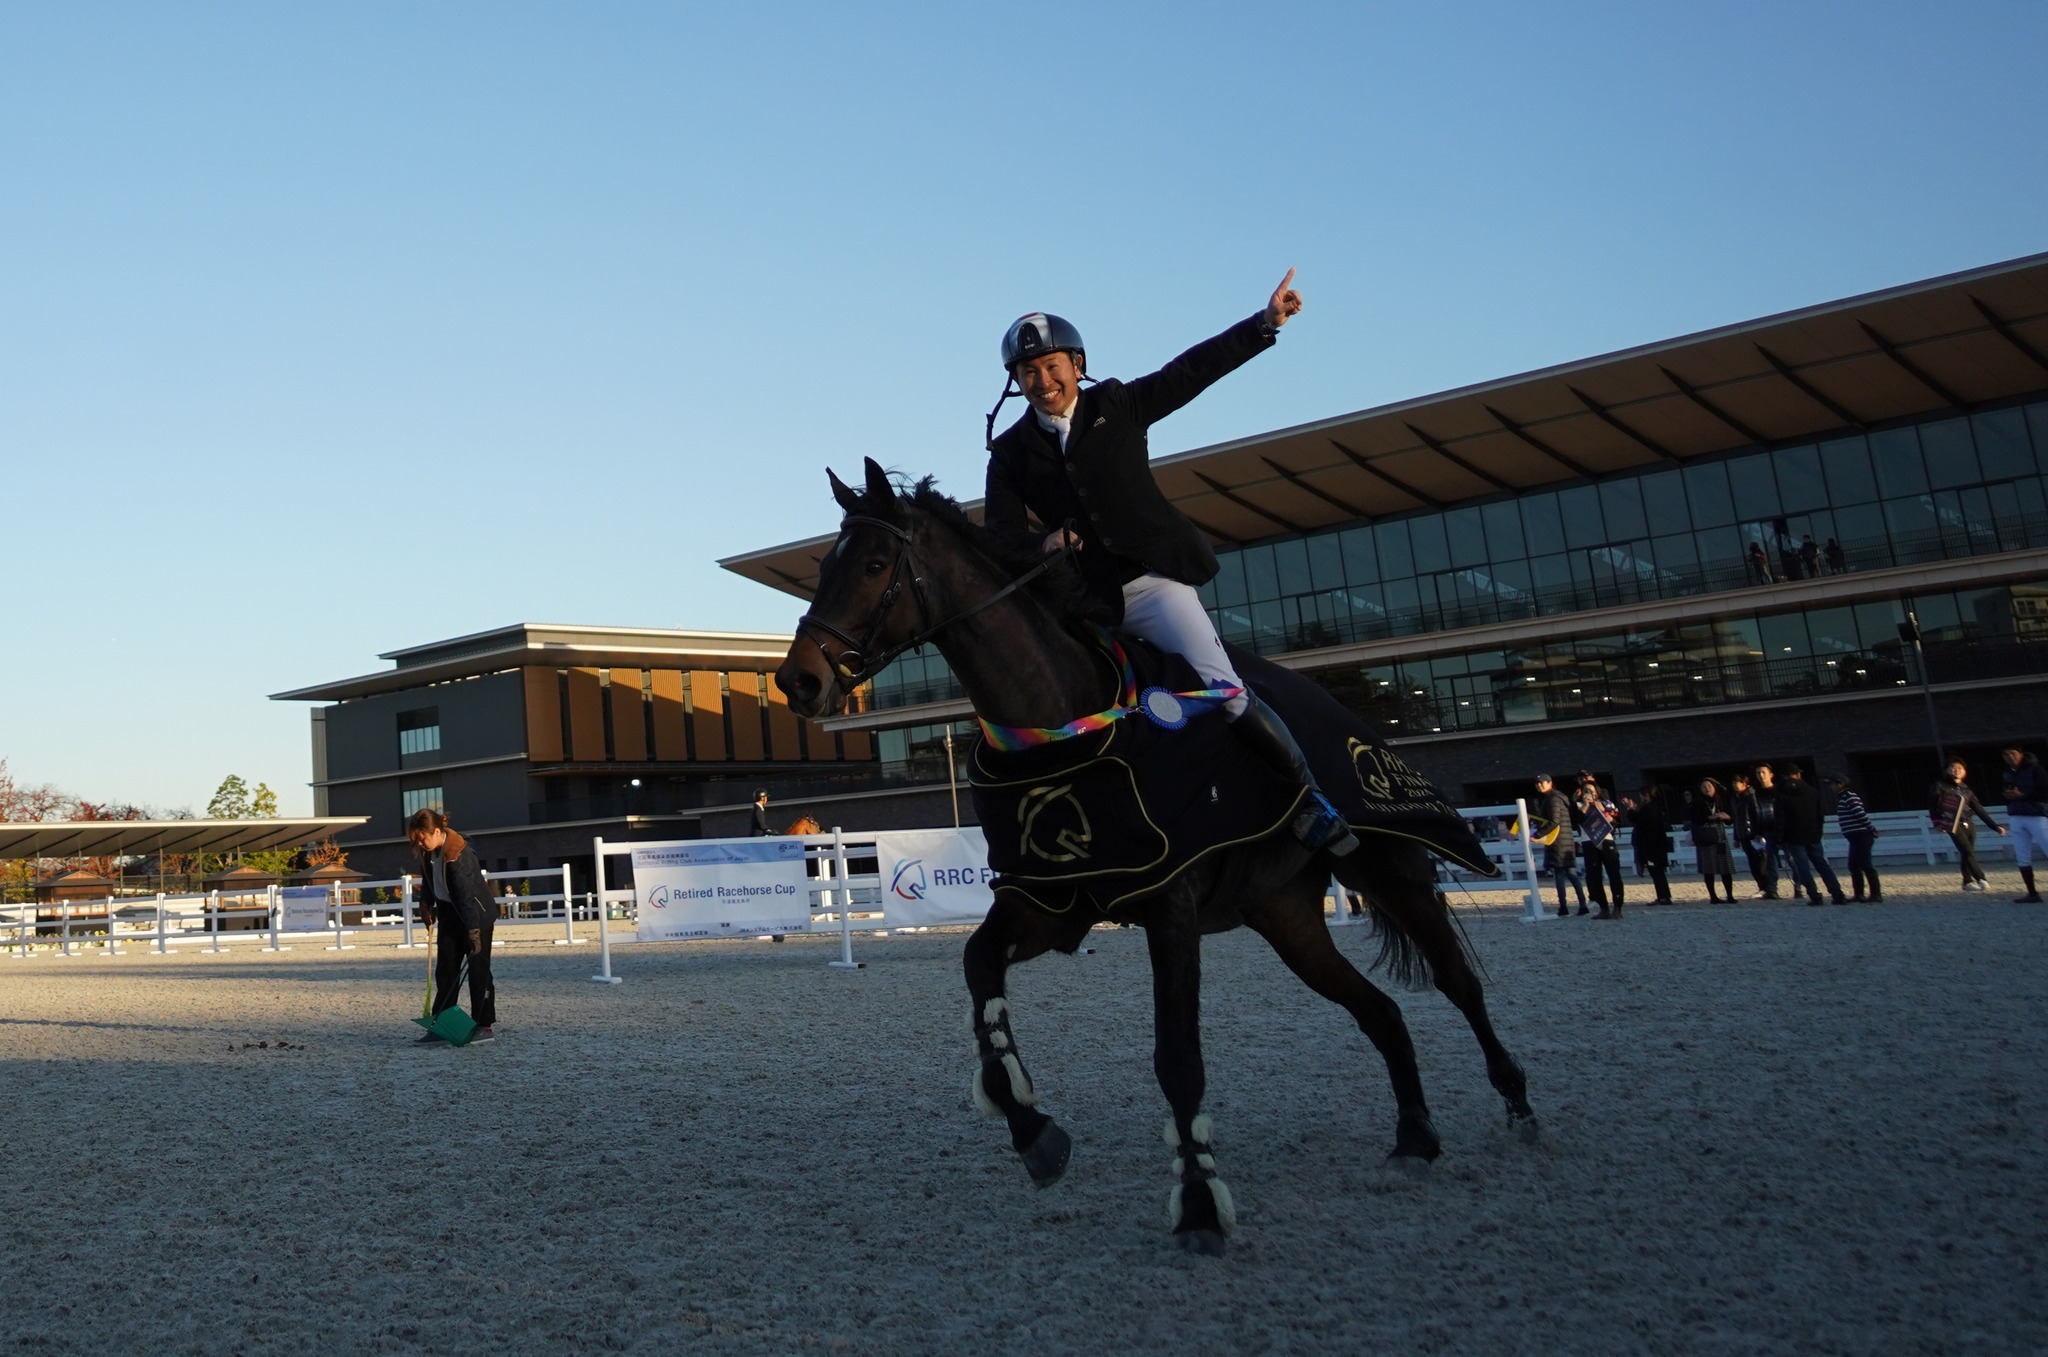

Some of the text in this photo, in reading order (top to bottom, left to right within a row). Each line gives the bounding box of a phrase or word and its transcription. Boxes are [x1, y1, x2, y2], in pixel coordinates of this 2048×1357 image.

[934, 868, 974, 886] RRC
[674, 883, 795, 900] Retired Racehorse Cup
